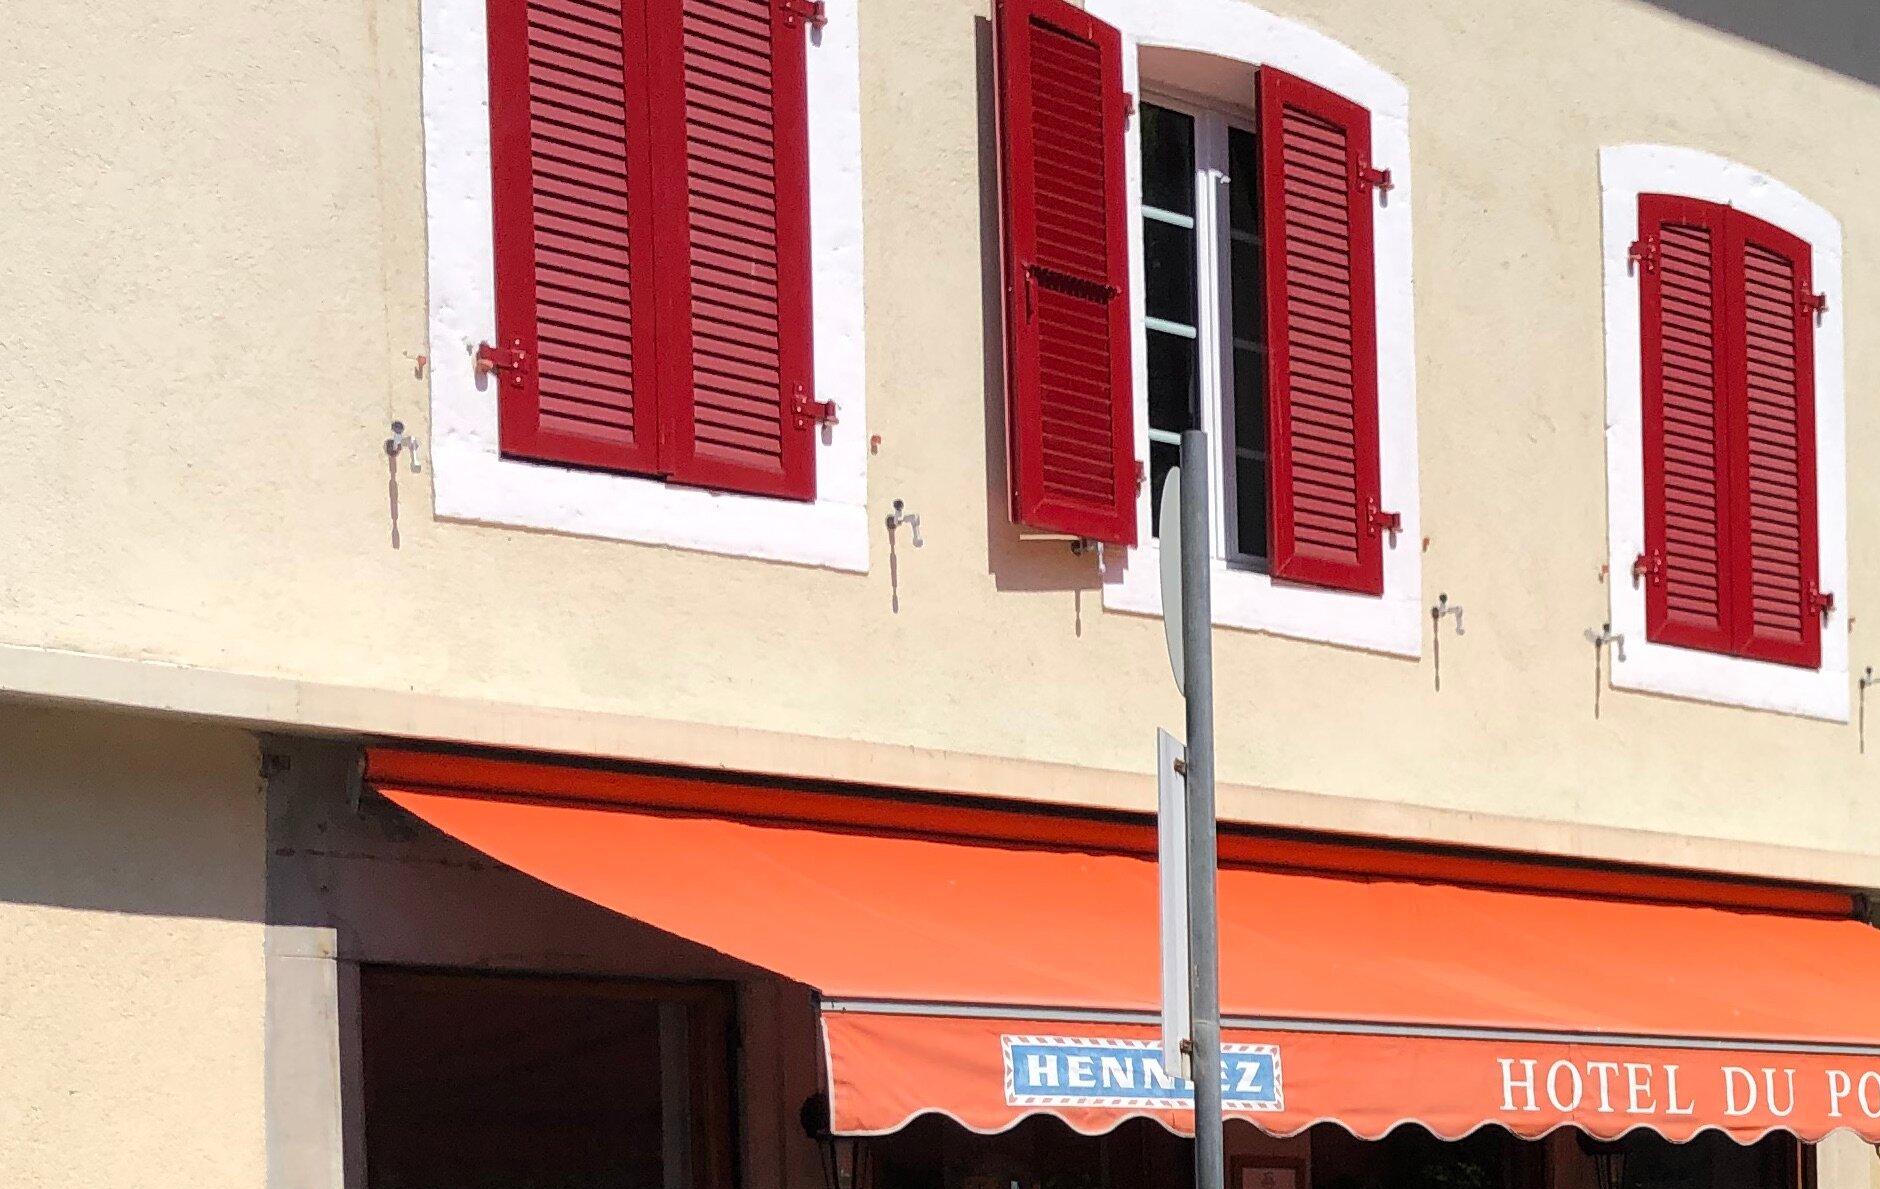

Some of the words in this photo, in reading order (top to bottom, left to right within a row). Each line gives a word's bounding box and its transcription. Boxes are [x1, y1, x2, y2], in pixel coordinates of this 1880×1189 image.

[1026, 1054, 1263, 1093] HENNZ
[1497, 1057, 1695, 1115] HOTEL
[1720, 1066, 1797, 1117] DU
